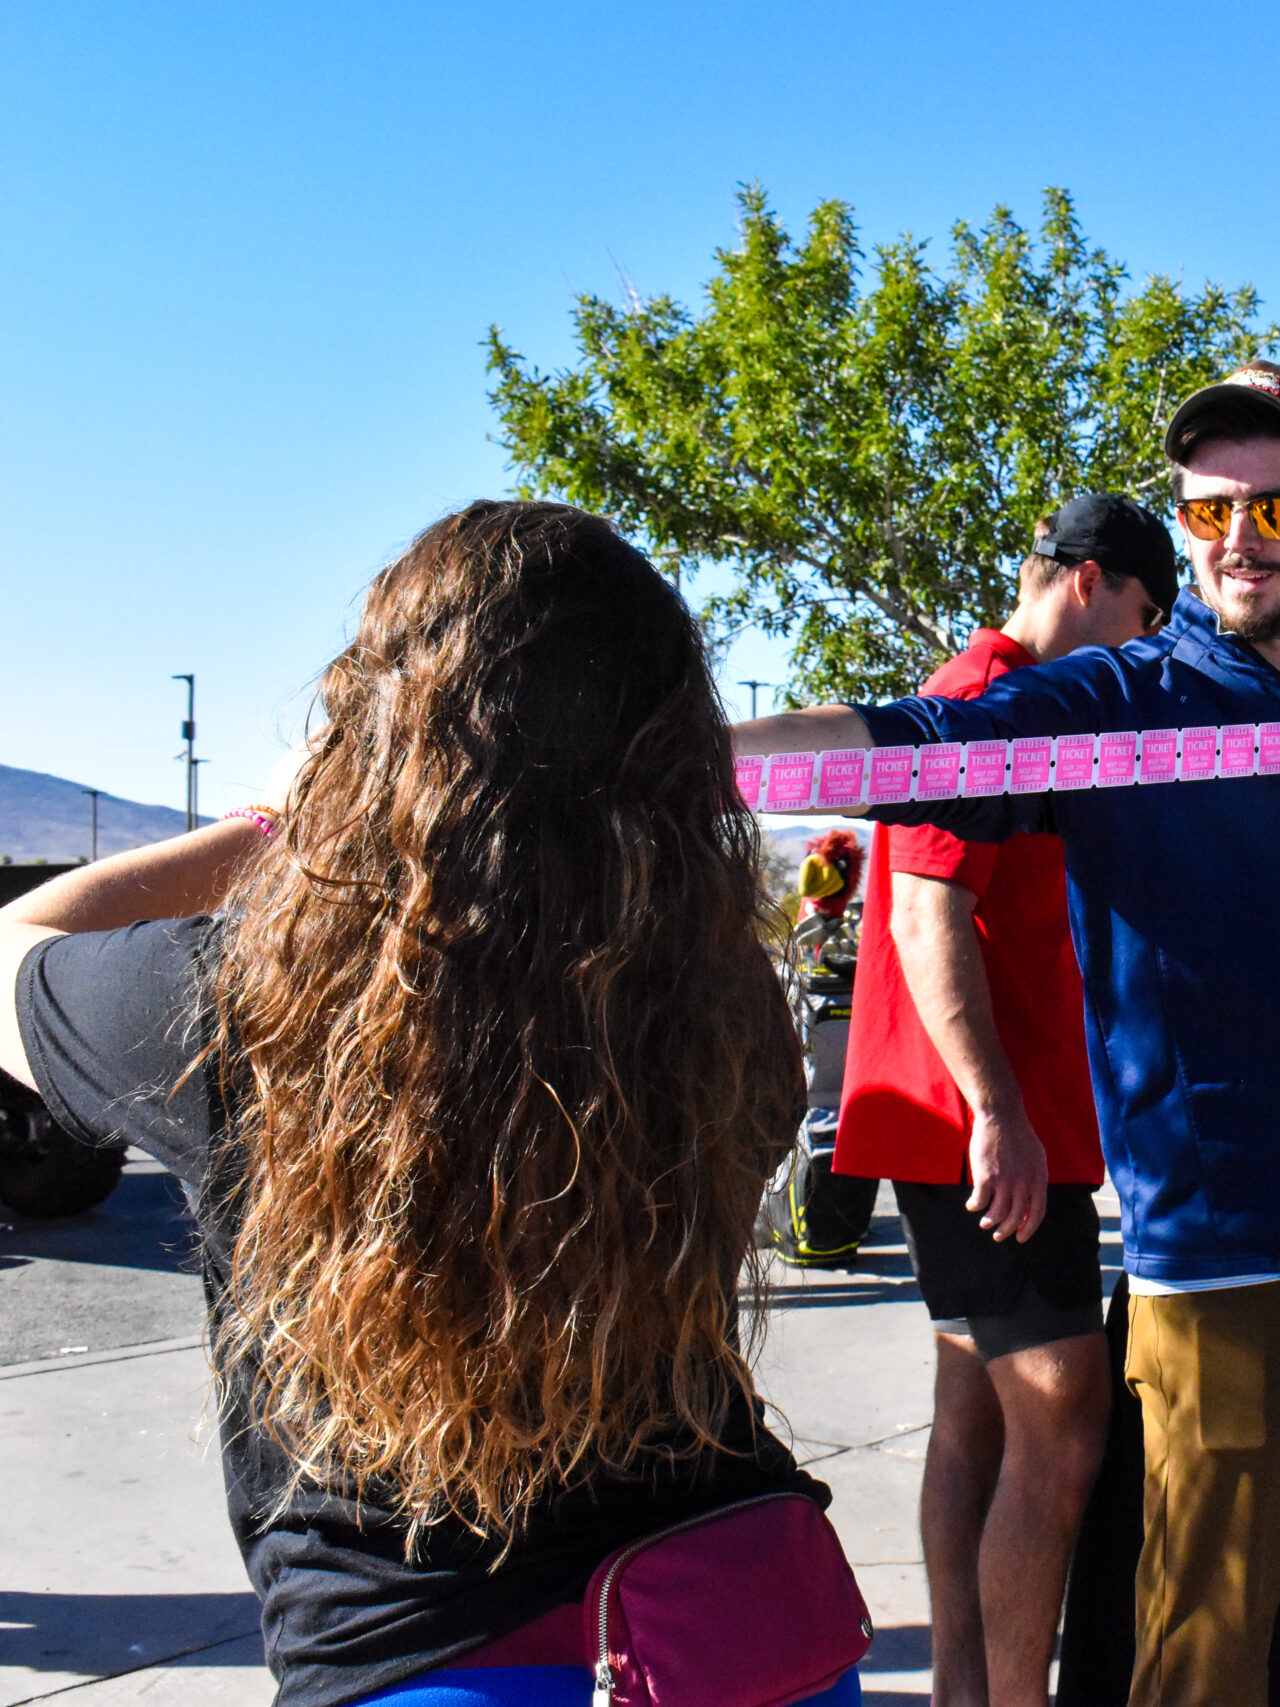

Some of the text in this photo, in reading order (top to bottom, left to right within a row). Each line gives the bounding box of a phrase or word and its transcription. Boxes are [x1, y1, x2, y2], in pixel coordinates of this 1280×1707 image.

[1146, 744, 1173, 754] TICKET
[1186, 741, 1212, 751] TICKET
[1226, 738, 1251, 749] TICKET
[1017, 752, 1046, 763] TICKET
[1061, 749, 1090, 760] TICKET
[1103, 747, 1132, 758] TICKET
[924, 758, 955, 770] TICKET
[971, 755, 1002, 766] TICKET
[825, 764, 860, 775] TICKET
[875, 762, 908, 773] TICKET
[774, 768, 810, 779] TICKET
